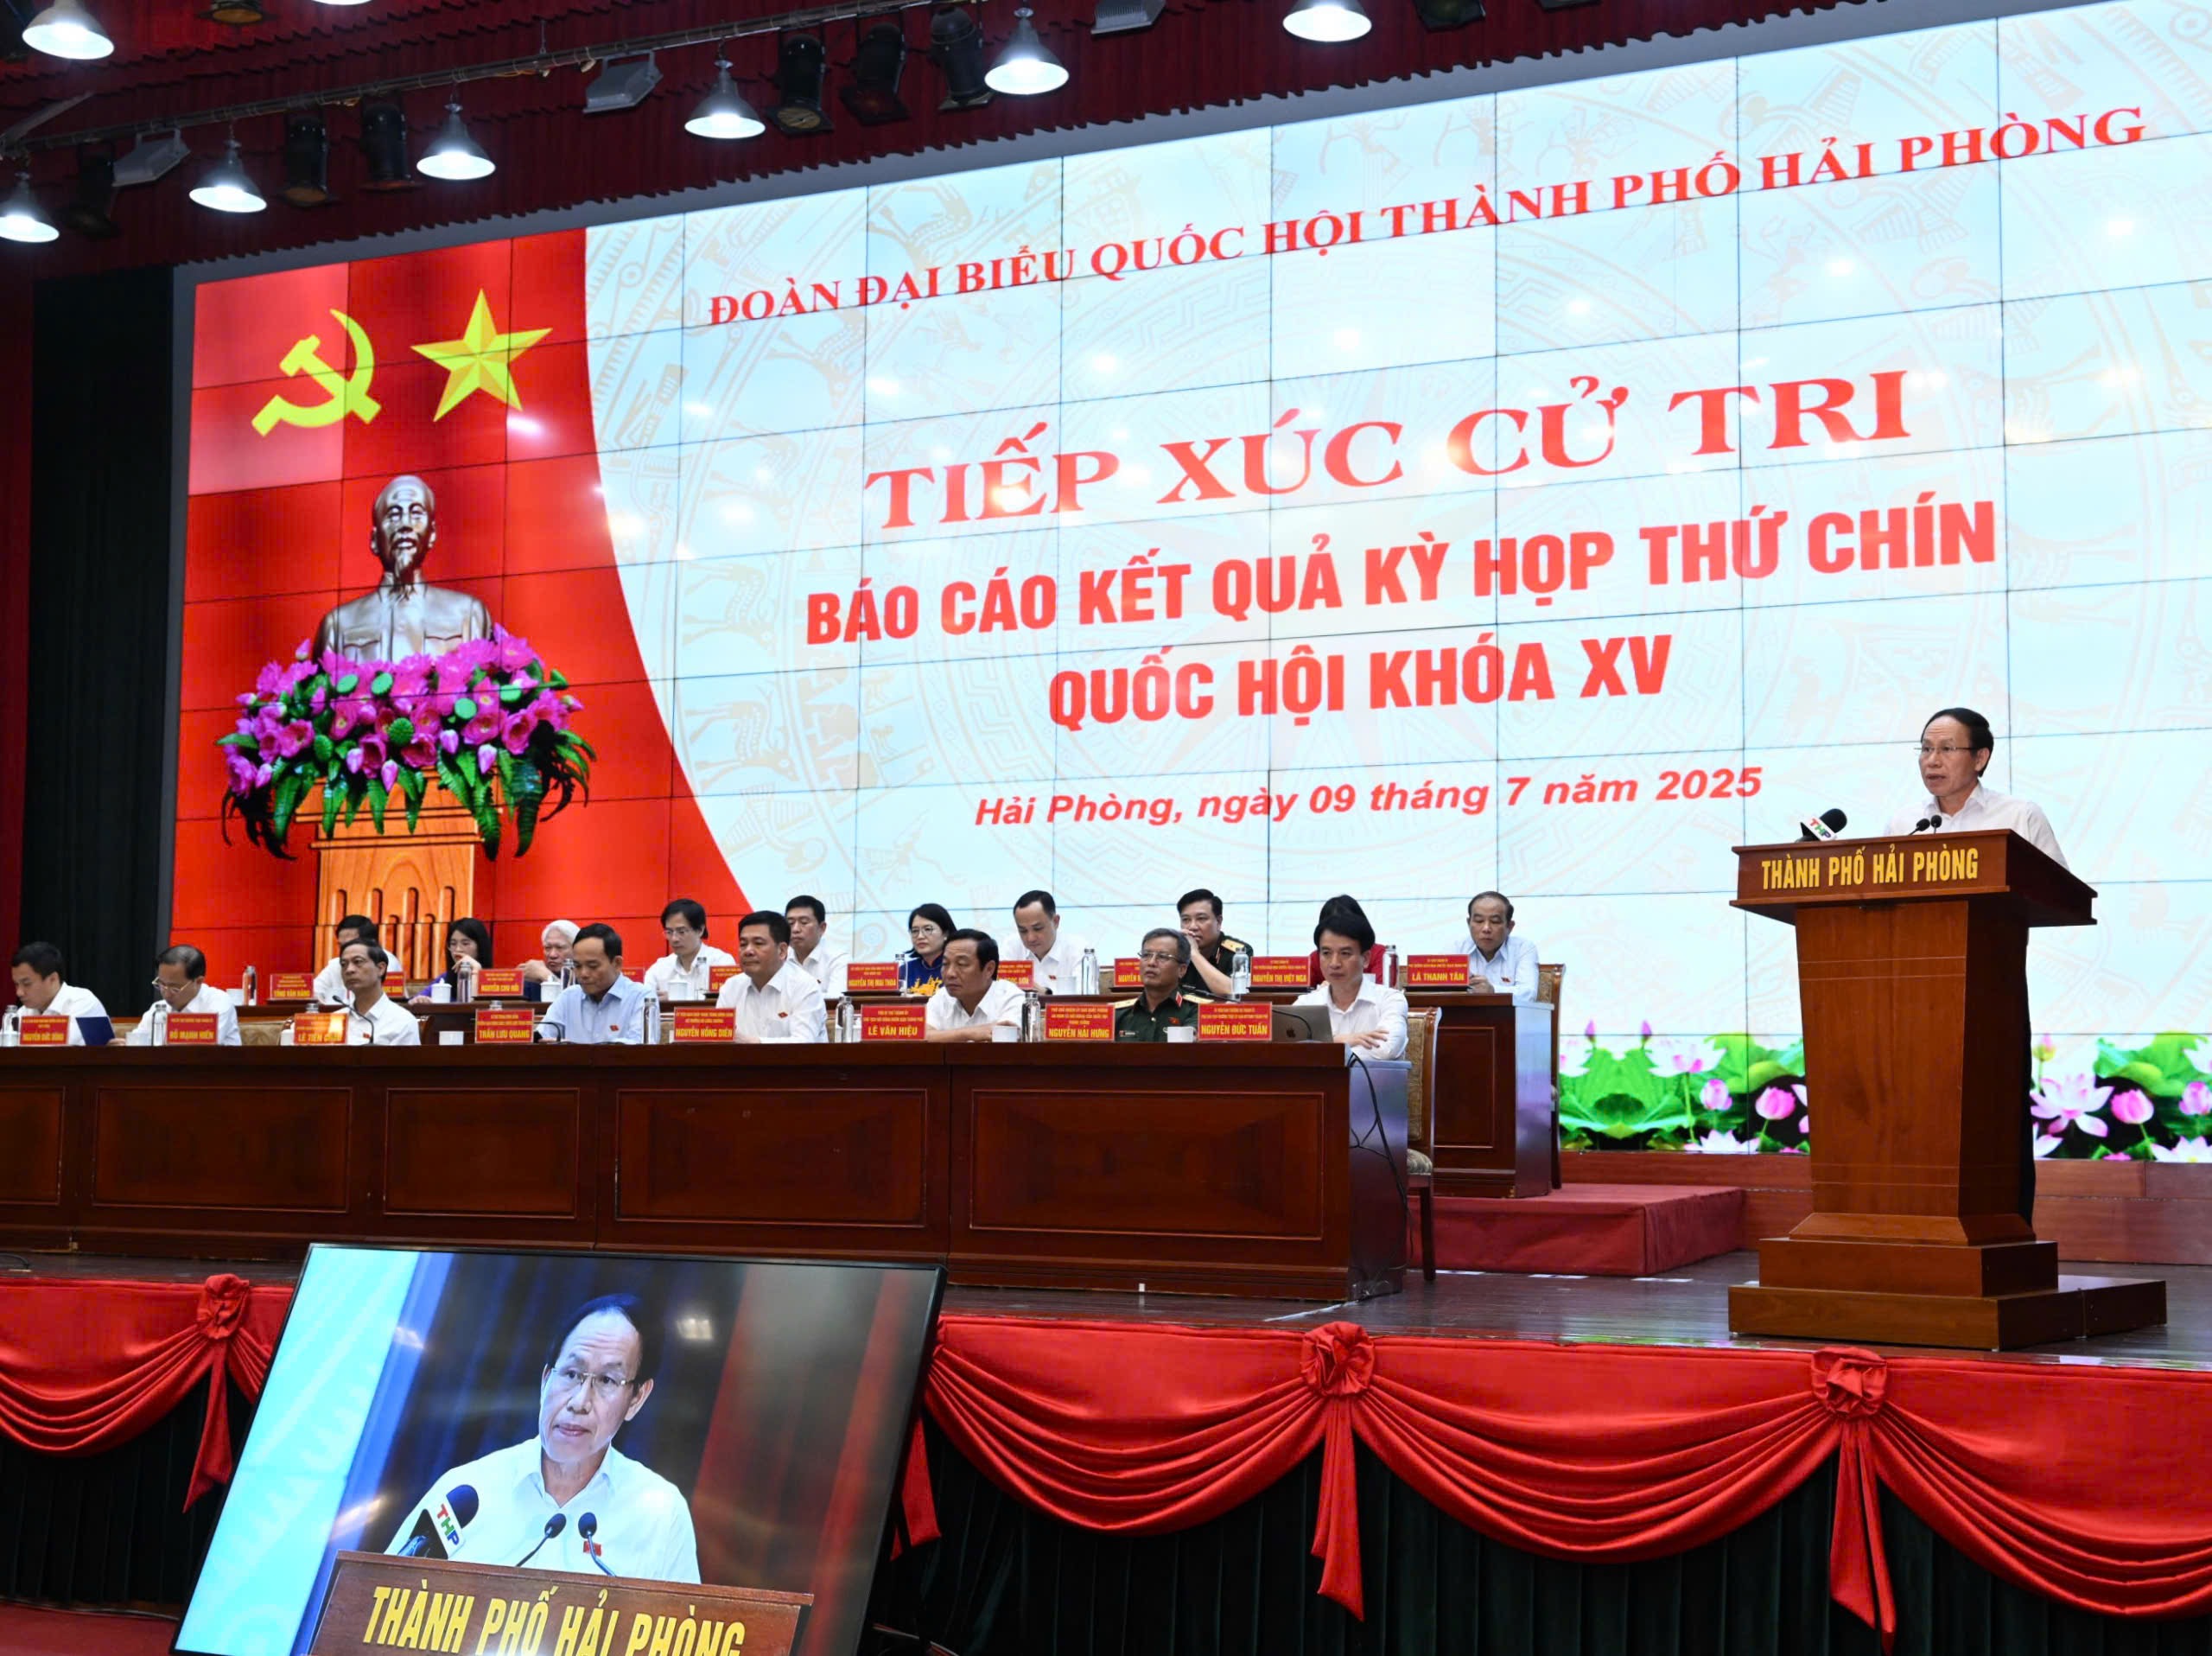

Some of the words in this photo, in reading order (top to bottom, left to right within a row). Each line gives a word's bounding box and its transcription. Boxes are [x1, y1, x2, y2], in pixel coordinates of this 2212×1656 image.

[711, 278, 838, 324] ĐOÀN
[859, 268, 938, 309] ĐẠI
[958, 246, 1073, 293] BIỂU
[1092, 228, 1243, 280] QUỐC
[1265, 212, 1362, 256] HỘI
[1381, 182, 1588, 237] THÀNH
[1614, 151, 1740, 208] PHỐ
[1761, 137, 1872, 188] HẢI
[1902, 108, 2145, 171] PHÒNG
[865, 423, 1118, 527] TIẾP
[1157, 410, 1402, 503] XÚC
[1448, 376, 1629, 475] CỬ
[1669, 371, 1910, 455] TRI
[808, 578, 918, 645] BÁO
[942, 567, 1056, 634] CÁO
[1080, 548, 1192, 624] KẾT
[1213, 534, 1342, 621] QUẢ
[1366, 532, 1449, 605] KỲ
[1474, 532, 1614, 606] HỌP
[1640, 506, 1788, 584] THỨ
[1808, 492, 1994, 573] CHÍN
[1050, 646, 1213, 731] QUỐC
[1238, 645, 1344, 726] HỘI
[1370, 633, 1554, 709] KHÓA
[1581, 635, 1671, 697] XV
[976, 797, 1036, 825] Hải
[1047, 793, 1182, 825] Phòng,
[1198, 788, 1298, 823] ngày
[1310, 785, 1356, 813] 09
[1371, 780, 1489, 815] tháng
[1509, 777, 1531, 805] 7
[1544, 774, 1637, 804] năm
[1656, 767, 1762, 800] 2025
[1810, 818, 1831, 838] THP
[1762, 854, 1820, 889] THÀNH
[1828, 846, 1866, 886] PHỐ
[1873, 844, 1904, 884] HẢI
[1913, 844, 1979, 882] PHÒNG
[868, 1025, 878, 1035] LÊ
[880, 1025, 897, 1035] VĂN
[899, 1025, 918, 1037] HIỆU
[1201, 1022, 1230, 1035] NGUYỄN
[1232, 1022, 1246, 1035] ĐỨC
[1249, 1022, 1268, 1035] TUẤN
[437, 1503, 460, 1545] THP
[363, 1579, 474, 1653] THÀNH
[474, 1586, 559, 1656] PHỐ
[553, 1589, 620, 1656] HẢI
[626, 1605, 745, 1656] PHÒNG
